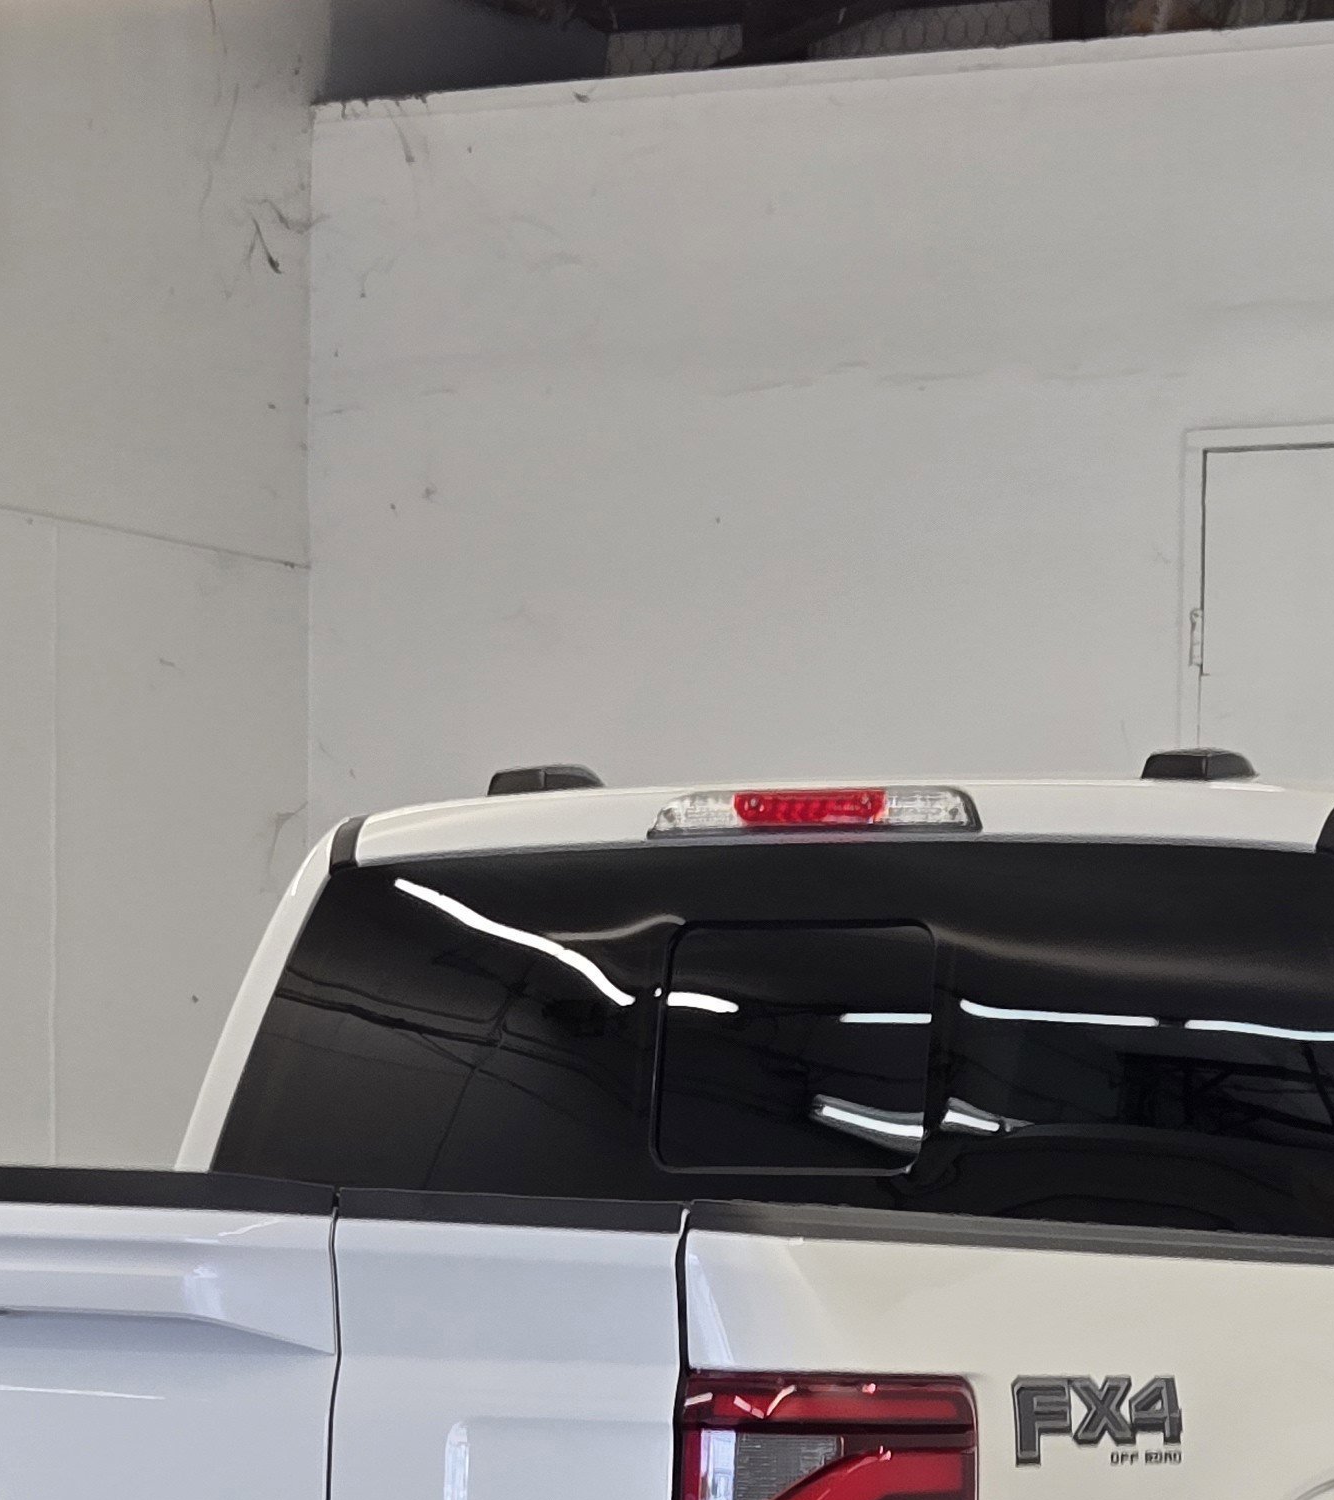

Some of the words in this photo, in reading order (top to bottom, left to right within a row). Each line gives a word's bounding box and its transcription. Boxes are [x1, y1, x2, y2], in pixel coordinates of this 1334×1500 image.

[1011, 1375, 1183, 1468] FX4
[1110, 1450, 1139, 1466] OFF
[1144, 1450, 1182, 1465] ROAD
